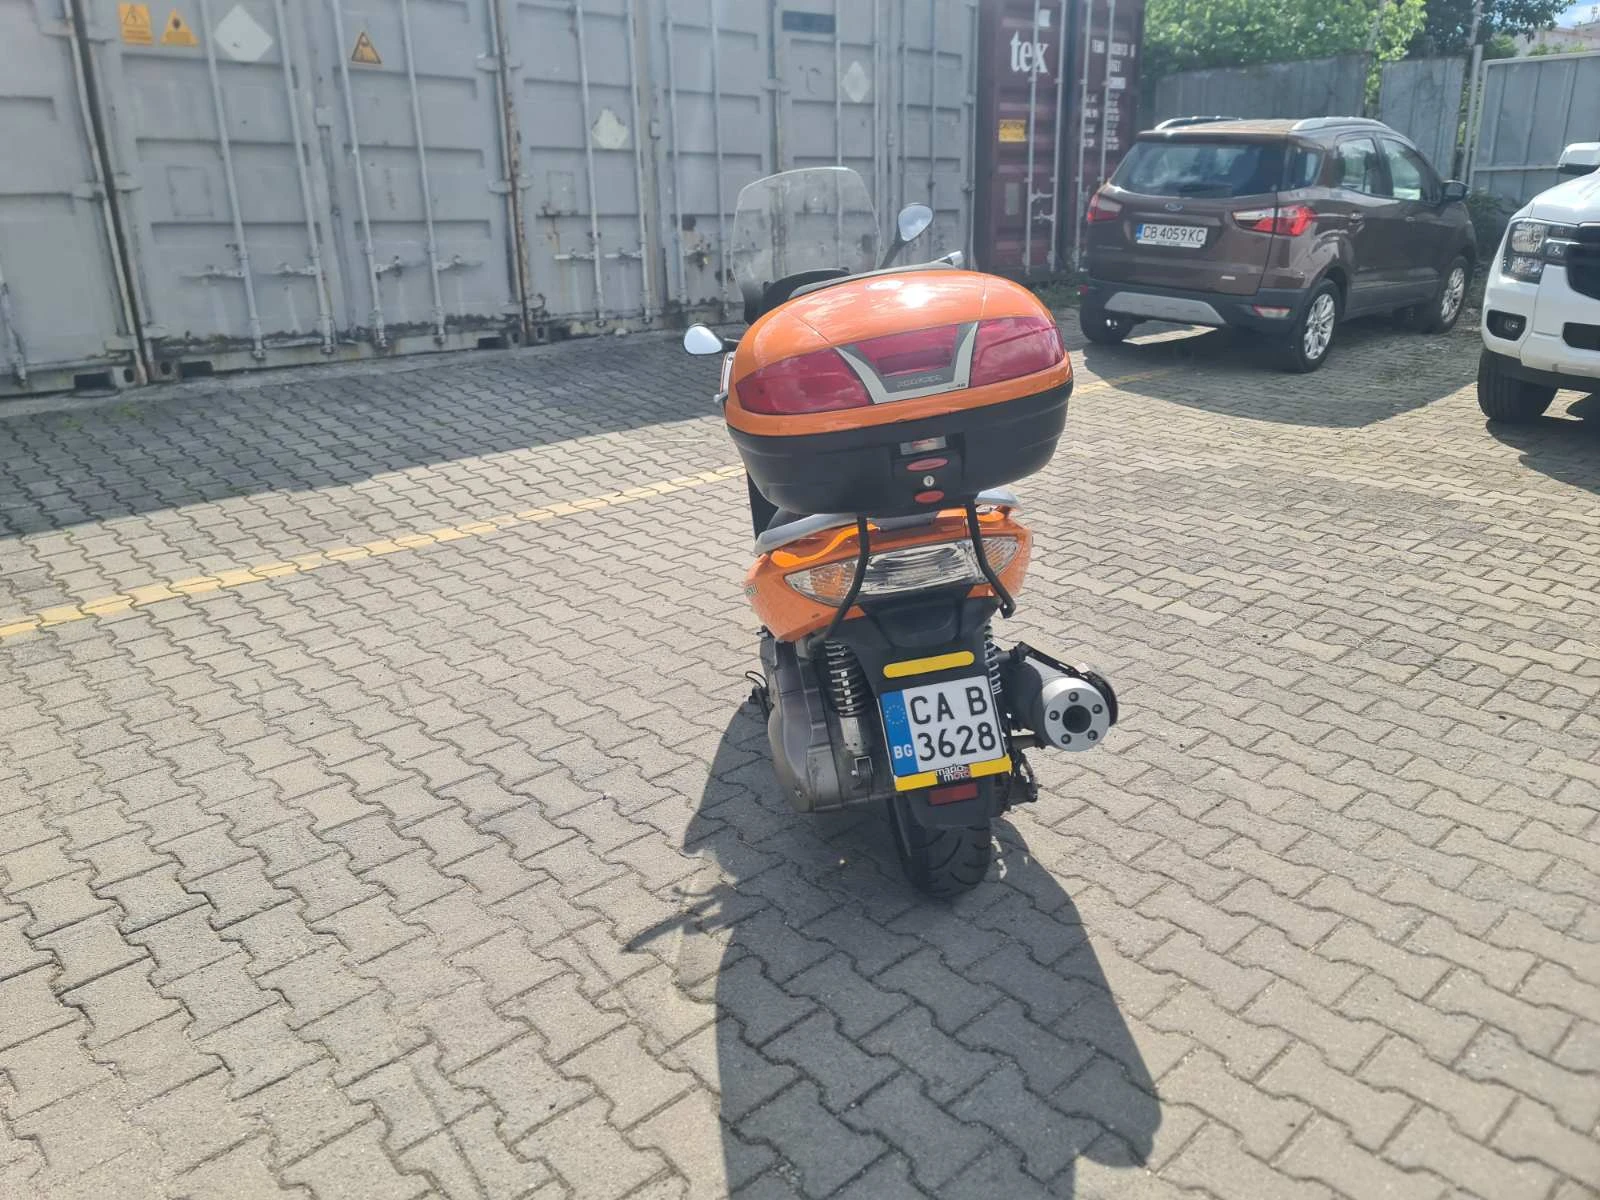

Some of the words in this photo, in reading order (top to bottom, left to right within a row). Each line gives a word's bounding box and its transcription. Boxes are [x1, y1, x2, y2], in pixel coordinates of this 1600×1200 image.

[1010, 30, 1049, 73] tex
[1160, 227, 1187, 241] 4059
[1188, 229, 1205, 242] KC
[910, 692, 955, 725] CA
[965, 686, 988, 716] B
[893, 743, 913, 759] BG
[917, 722, 996, 761] 3628
